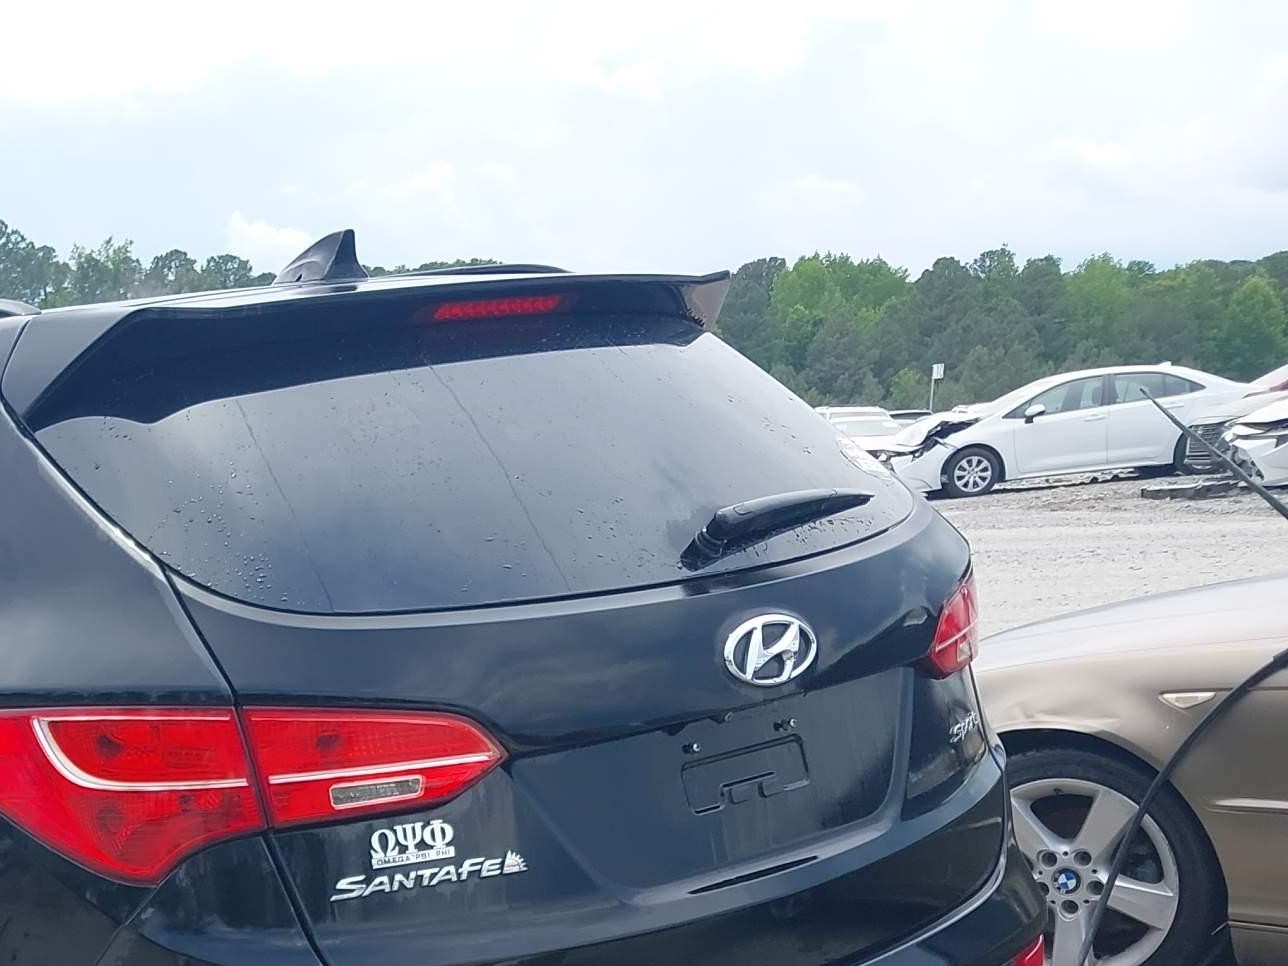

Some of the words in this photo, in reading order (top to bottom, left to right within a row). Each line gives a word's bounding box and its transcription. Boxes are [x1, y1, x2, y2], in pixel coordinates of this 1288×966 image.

[376, 856, 411, 867] OMEGA
[415, 852, 431, 861] PSI
[436, 848, 451, 857] PHI
